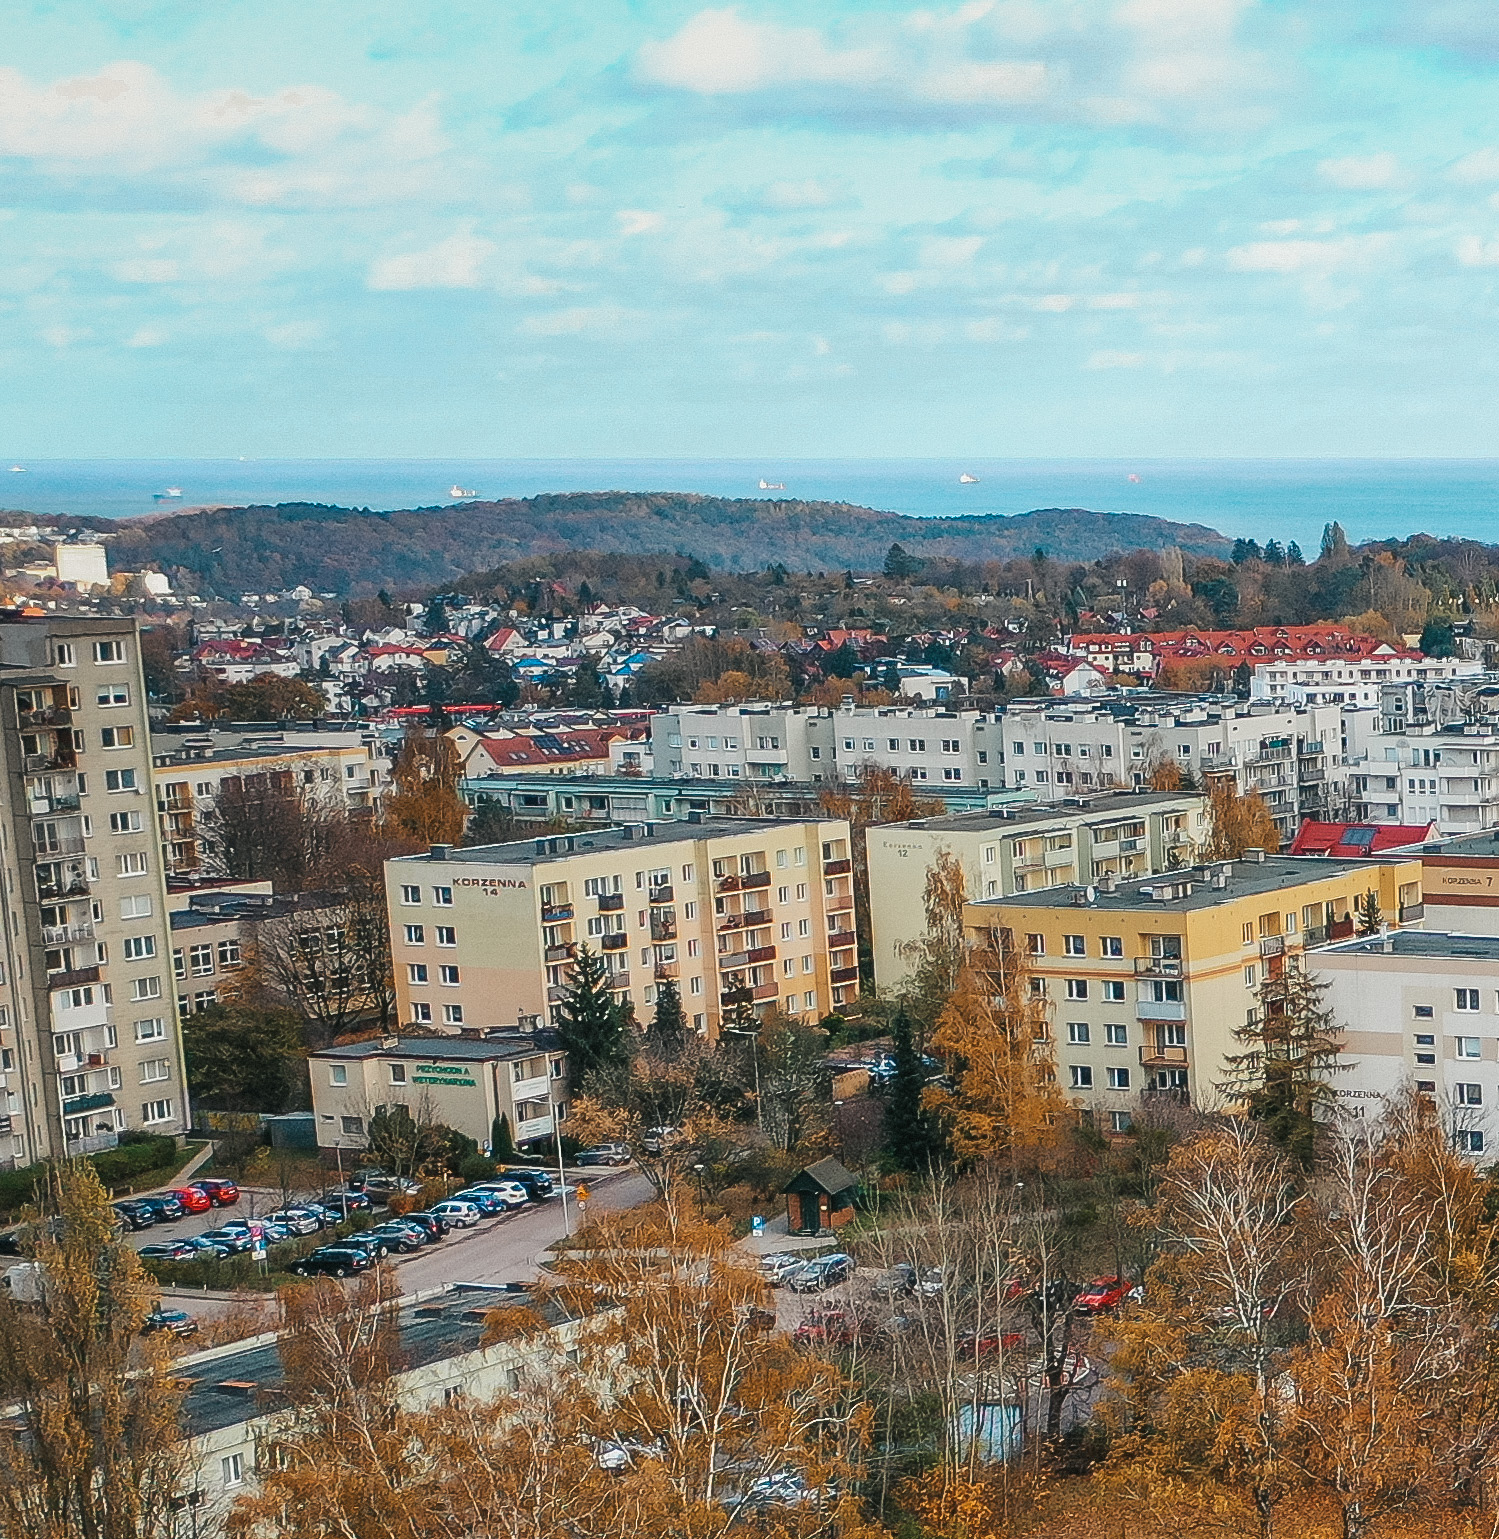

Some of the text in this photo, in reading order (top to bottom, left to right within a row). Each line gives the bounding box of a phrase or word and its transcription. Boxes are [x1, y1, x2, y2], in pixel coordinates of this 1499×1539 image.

[897, 849, 908, 858] 12
[452, 878, 527, 889] KORZENNA
[1486, 876, 1493, 887] 7
[482, 888, 498, 896] 14
[1352, 1106, 1365, 1118] 11
